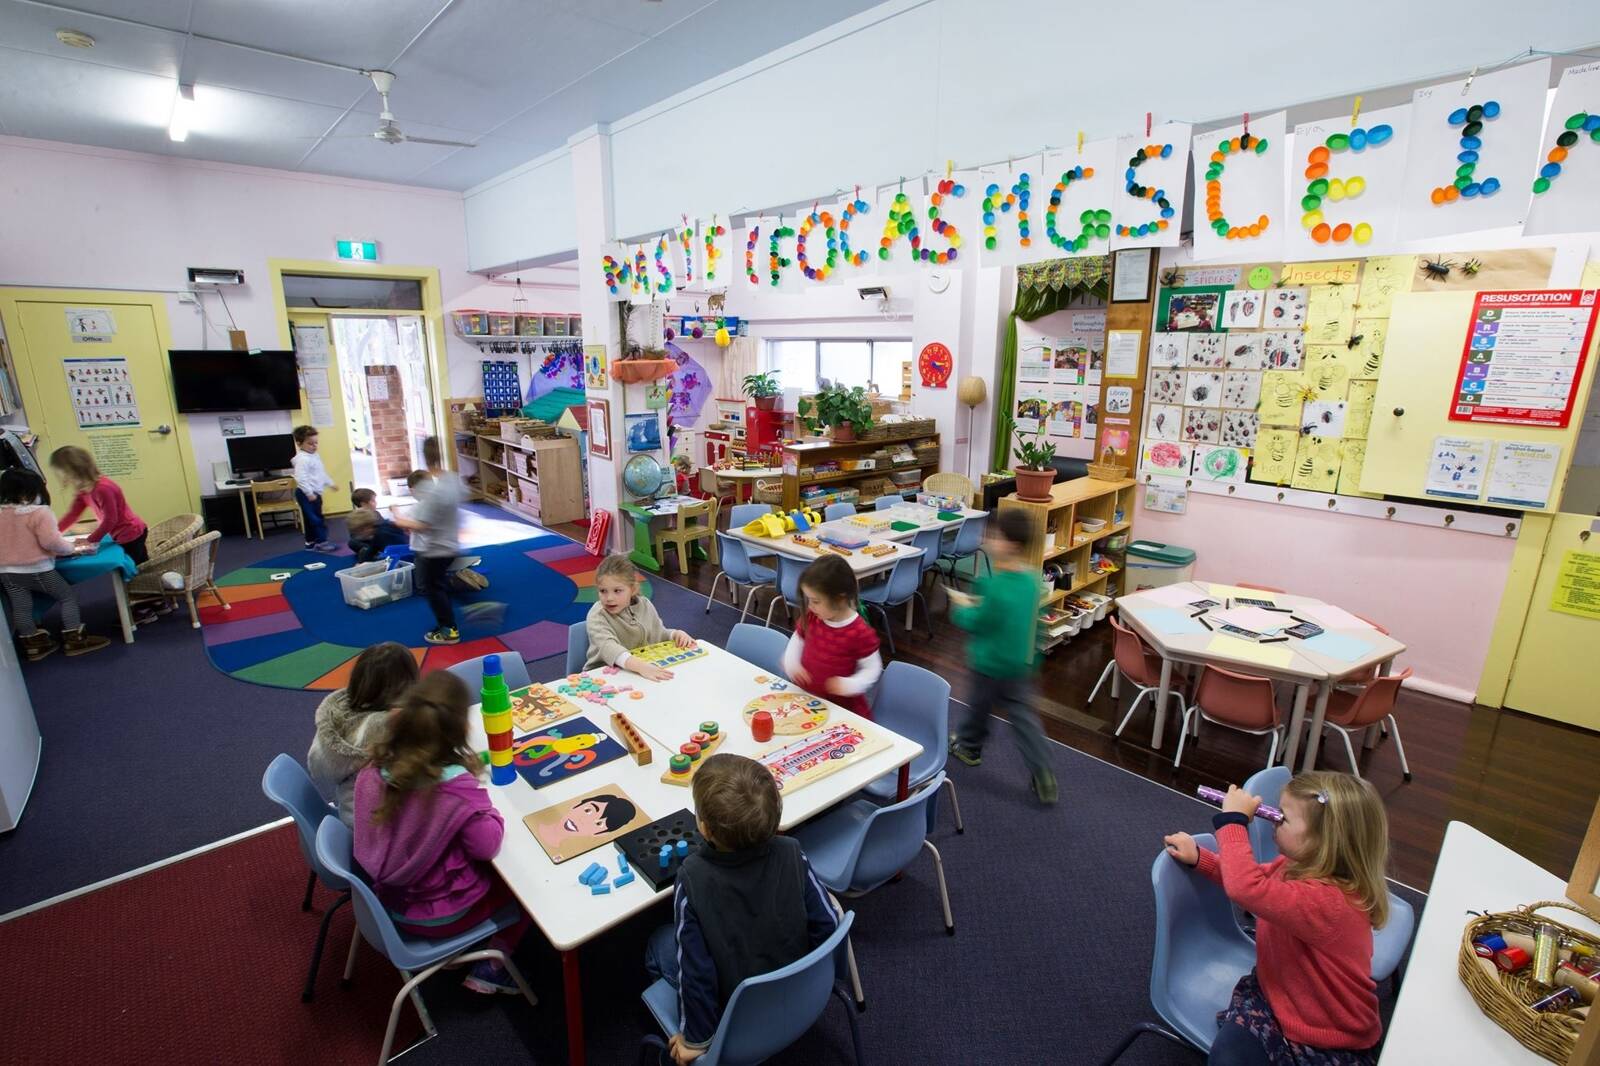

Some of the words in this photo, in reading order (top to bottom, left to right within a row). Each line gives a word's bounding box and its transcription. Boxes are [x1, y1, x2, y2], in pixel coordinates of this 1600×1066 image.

[982, 172, 1031, 250] M
[1046, 165, 1112, 253] G
[1115, 143, 1175, 237] S
[1205, 132, 1270, 240] C
[1301, 124, 1394, 244] E
[878, 193, 921, 261] A
[1288, 264, 1352, 282] Insects
[1480, 293, 1573, 303] RESUSCITATION
